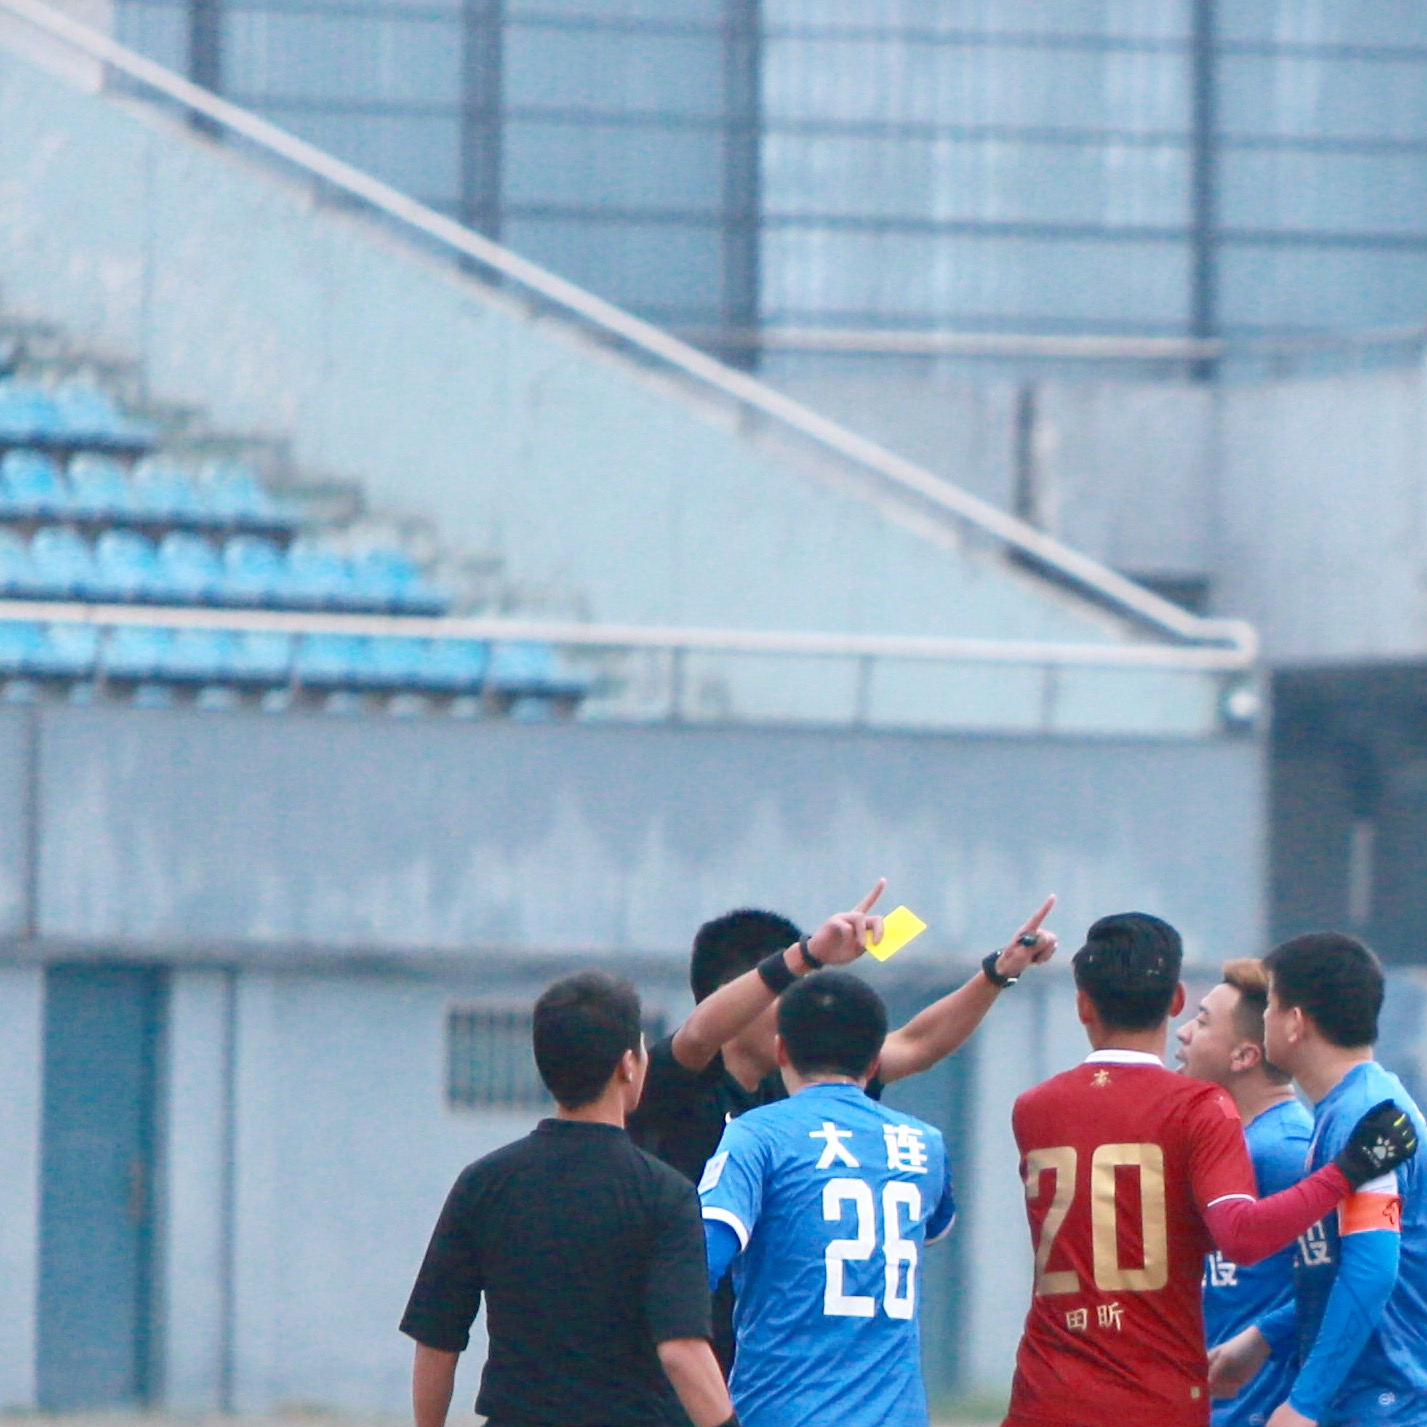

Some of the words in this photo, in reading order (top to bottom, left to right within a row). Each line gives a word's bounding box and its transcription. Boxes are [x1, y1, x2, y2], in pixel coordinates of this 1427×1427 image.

[808, 1122, 928, 1174] 大连
[823, 1178, 921, 1320] 26
[1026, 1143, 1168, 1296] 20
[1065, 1301, 1125, 1332] 田昕
